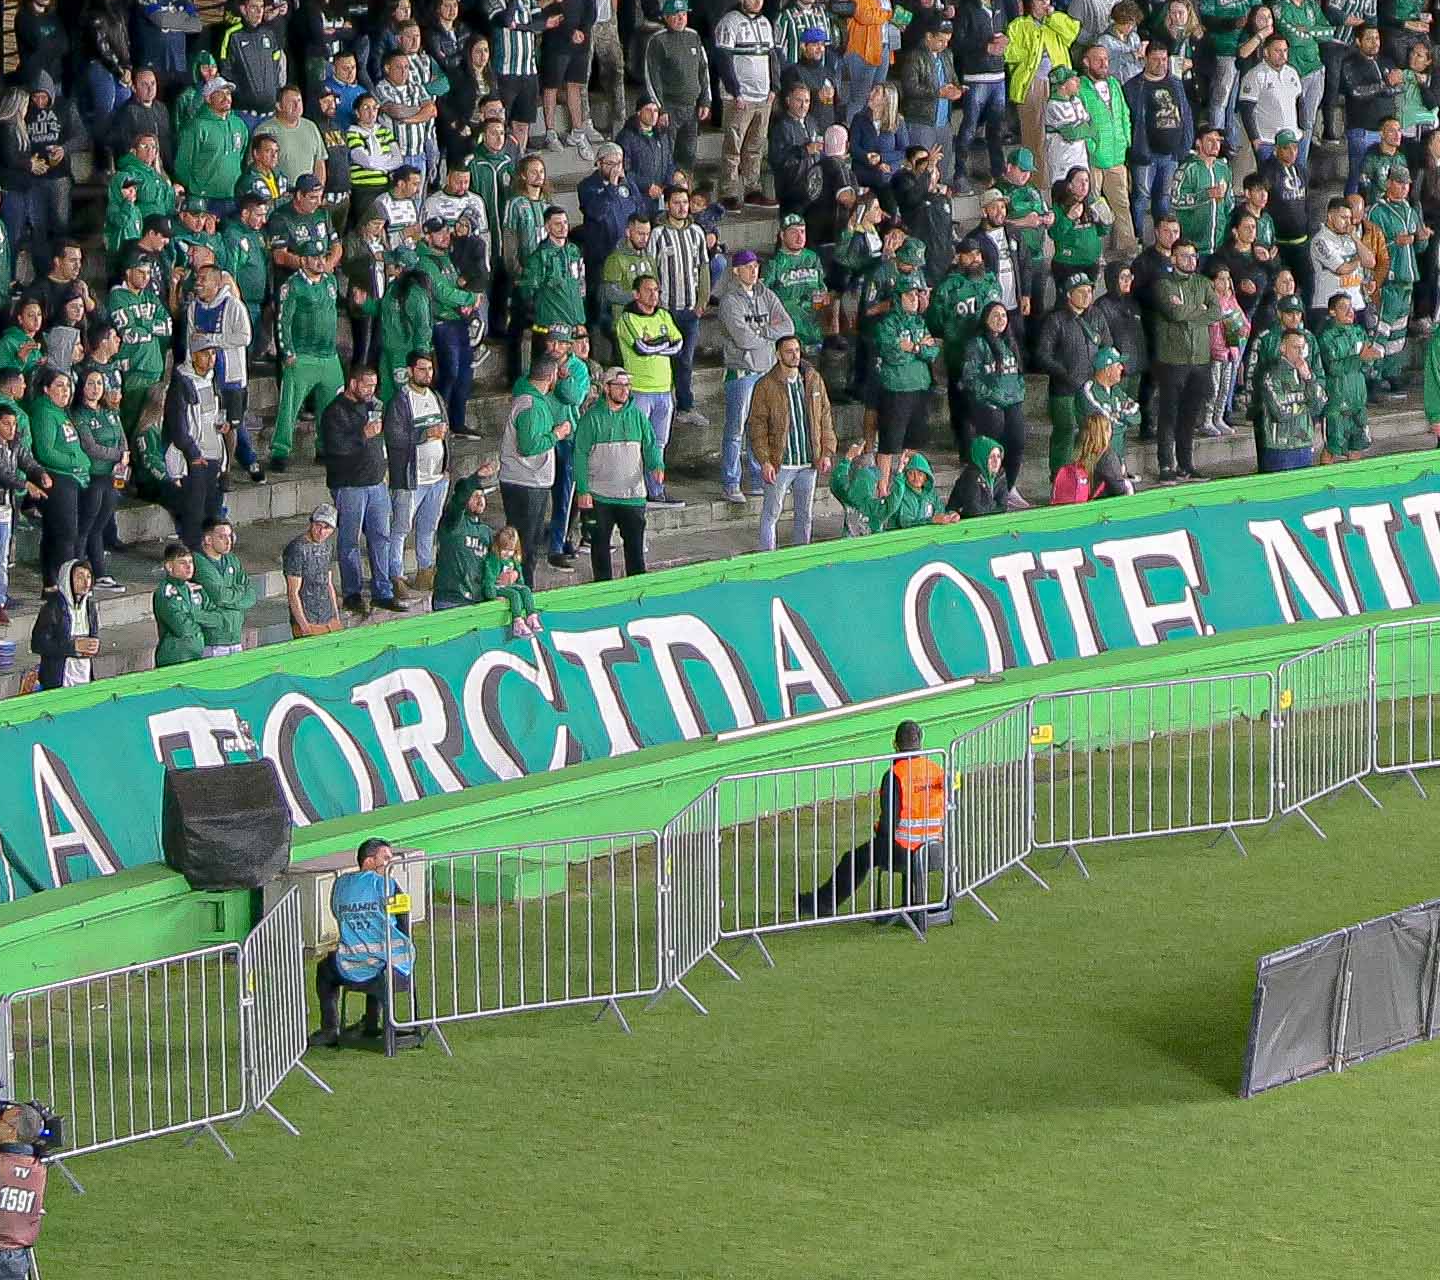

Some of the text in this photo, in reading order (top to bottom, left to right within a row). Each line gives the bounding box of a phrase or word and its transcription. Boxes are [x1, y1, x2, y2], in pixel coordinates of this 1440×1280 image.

[32, 743, 125, 888] A
[14, 1166, 31, 1179] TV
[0, 1186, 36, 1214] 1591
